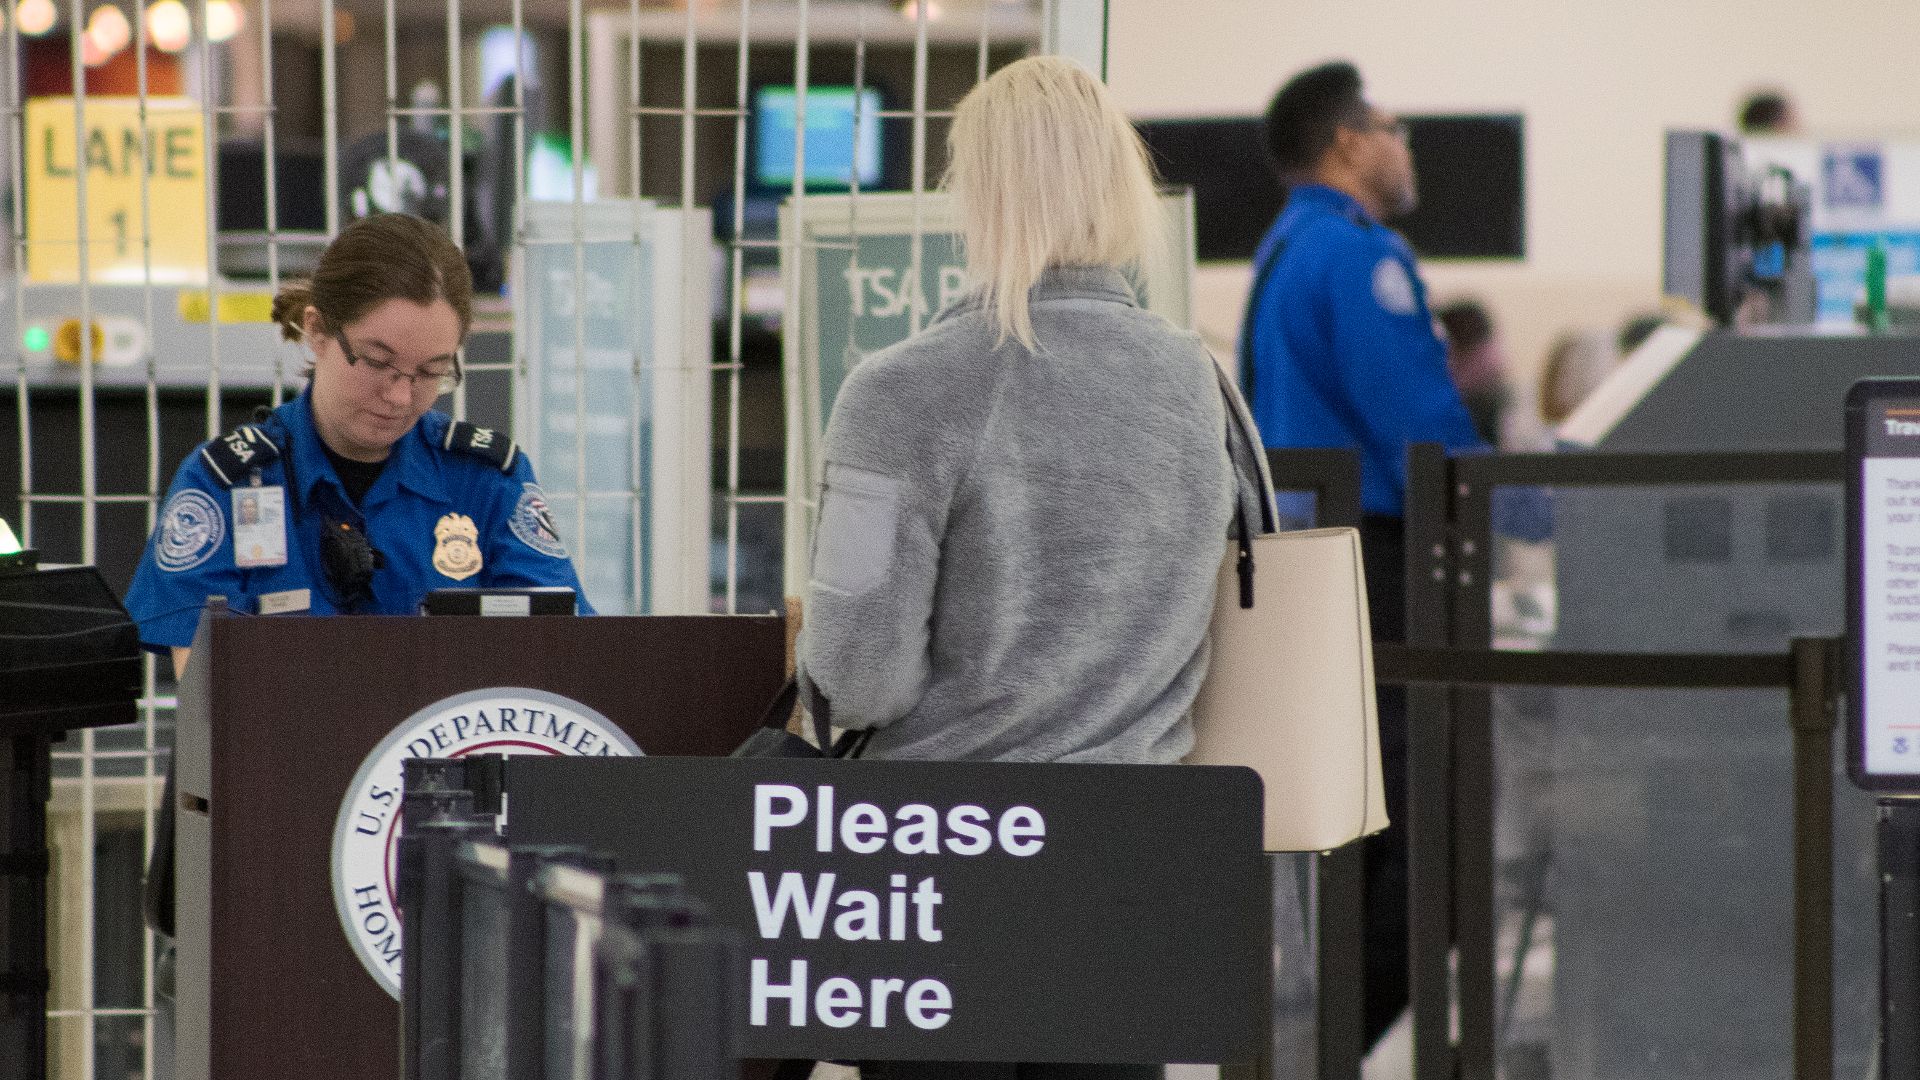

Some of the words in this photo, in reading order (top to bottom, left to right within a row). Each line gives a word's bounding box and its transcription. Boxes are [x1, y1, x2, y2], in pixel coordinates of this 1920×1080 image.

[43, 126, 198, 178] LANE
[109, 208, 128, 257] 1
[843, 267, 929, 317] TSA
[224, 430, 256, 463] TSA
[470, 427, 495, 449] TSA
[356, 785, 399, 836] U.S.
[753, 784, 1046, 857] Please
[353, 883, 402, 977] HOM
[748, 871, 943, 943] Wait
[750, 959, 953, 1030] Here
